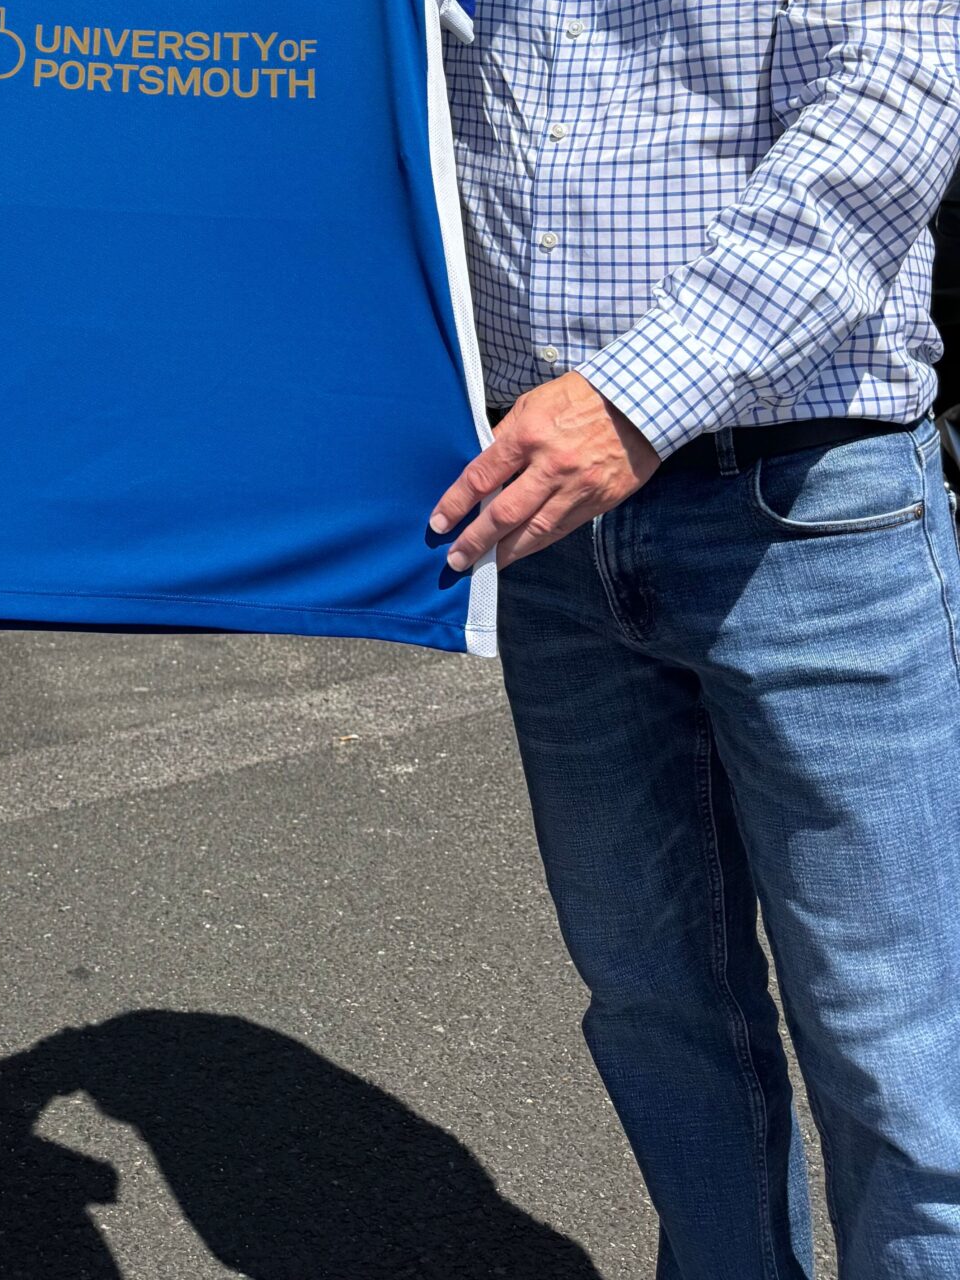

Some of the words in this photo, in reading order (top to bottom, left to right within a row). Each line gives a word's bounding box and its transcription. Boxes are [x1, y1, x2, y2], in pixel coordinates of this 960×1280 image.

[34, 24, 278, 61] UNIVERSITY
[278, 39, 317, 61] OF
[33, 59, 317, 99] PORTSMOUTH
